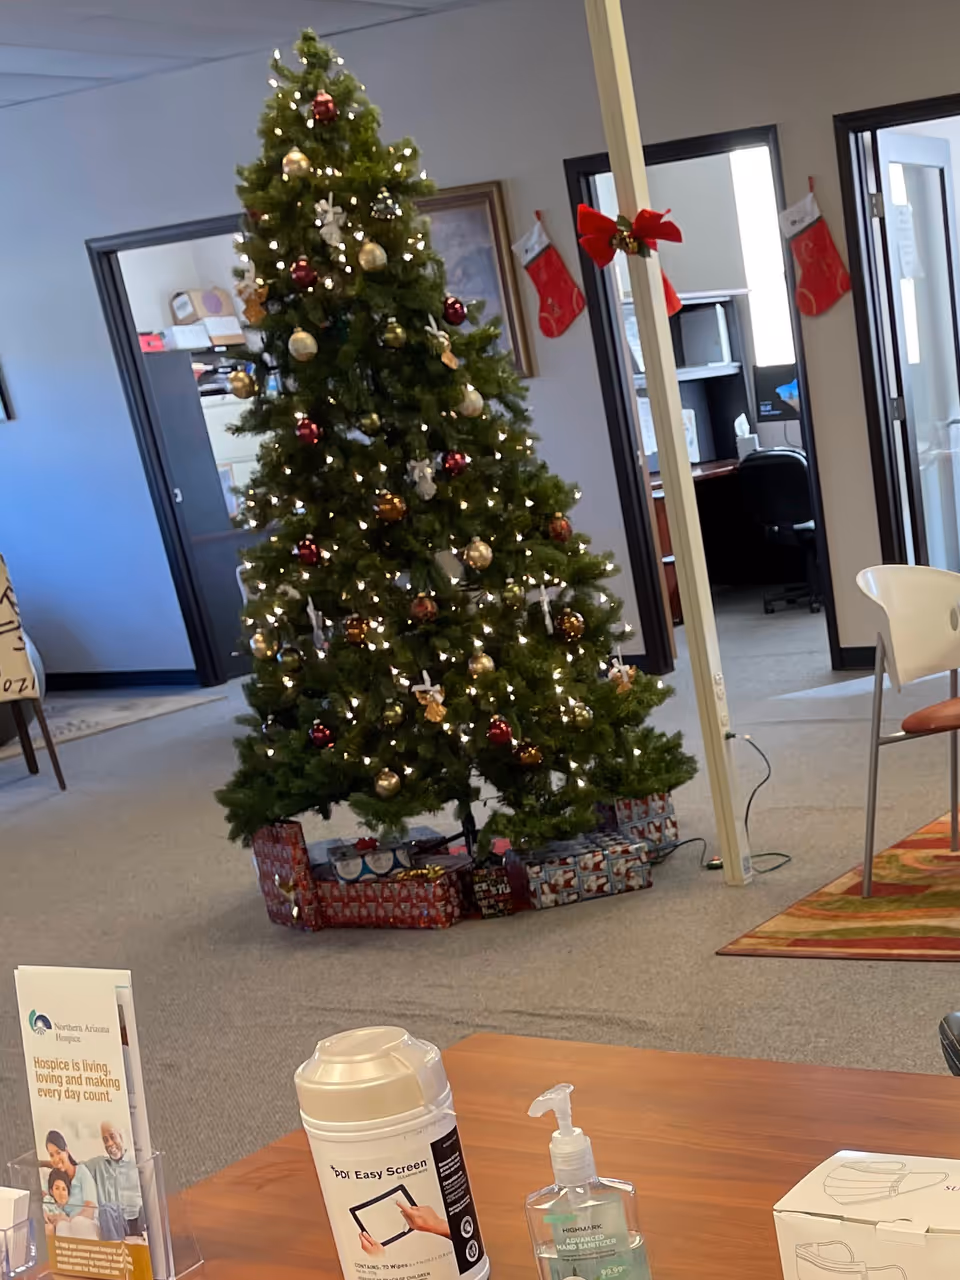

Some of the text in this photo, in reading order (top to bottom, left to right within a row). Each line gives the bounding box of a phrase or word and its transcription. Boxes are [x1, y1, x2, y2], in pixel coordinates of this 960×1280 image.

[54, 1023, 82, 1032] Northern
[34, 1056, 111, 1076] Hospice is living,
[35, 1071, 120, 1091] loving and making
[38, 1087, 112, 1102] every day count.
[354, 1170, 383, 1180] Easy
[386, 1159, 427, 1176] Screen
[562, 1223, 603, 1233] HIGHMARK
[566, 1234, 605, 1244] ADVANCED
[578, 1238, 617, 1250] SANITIZER
